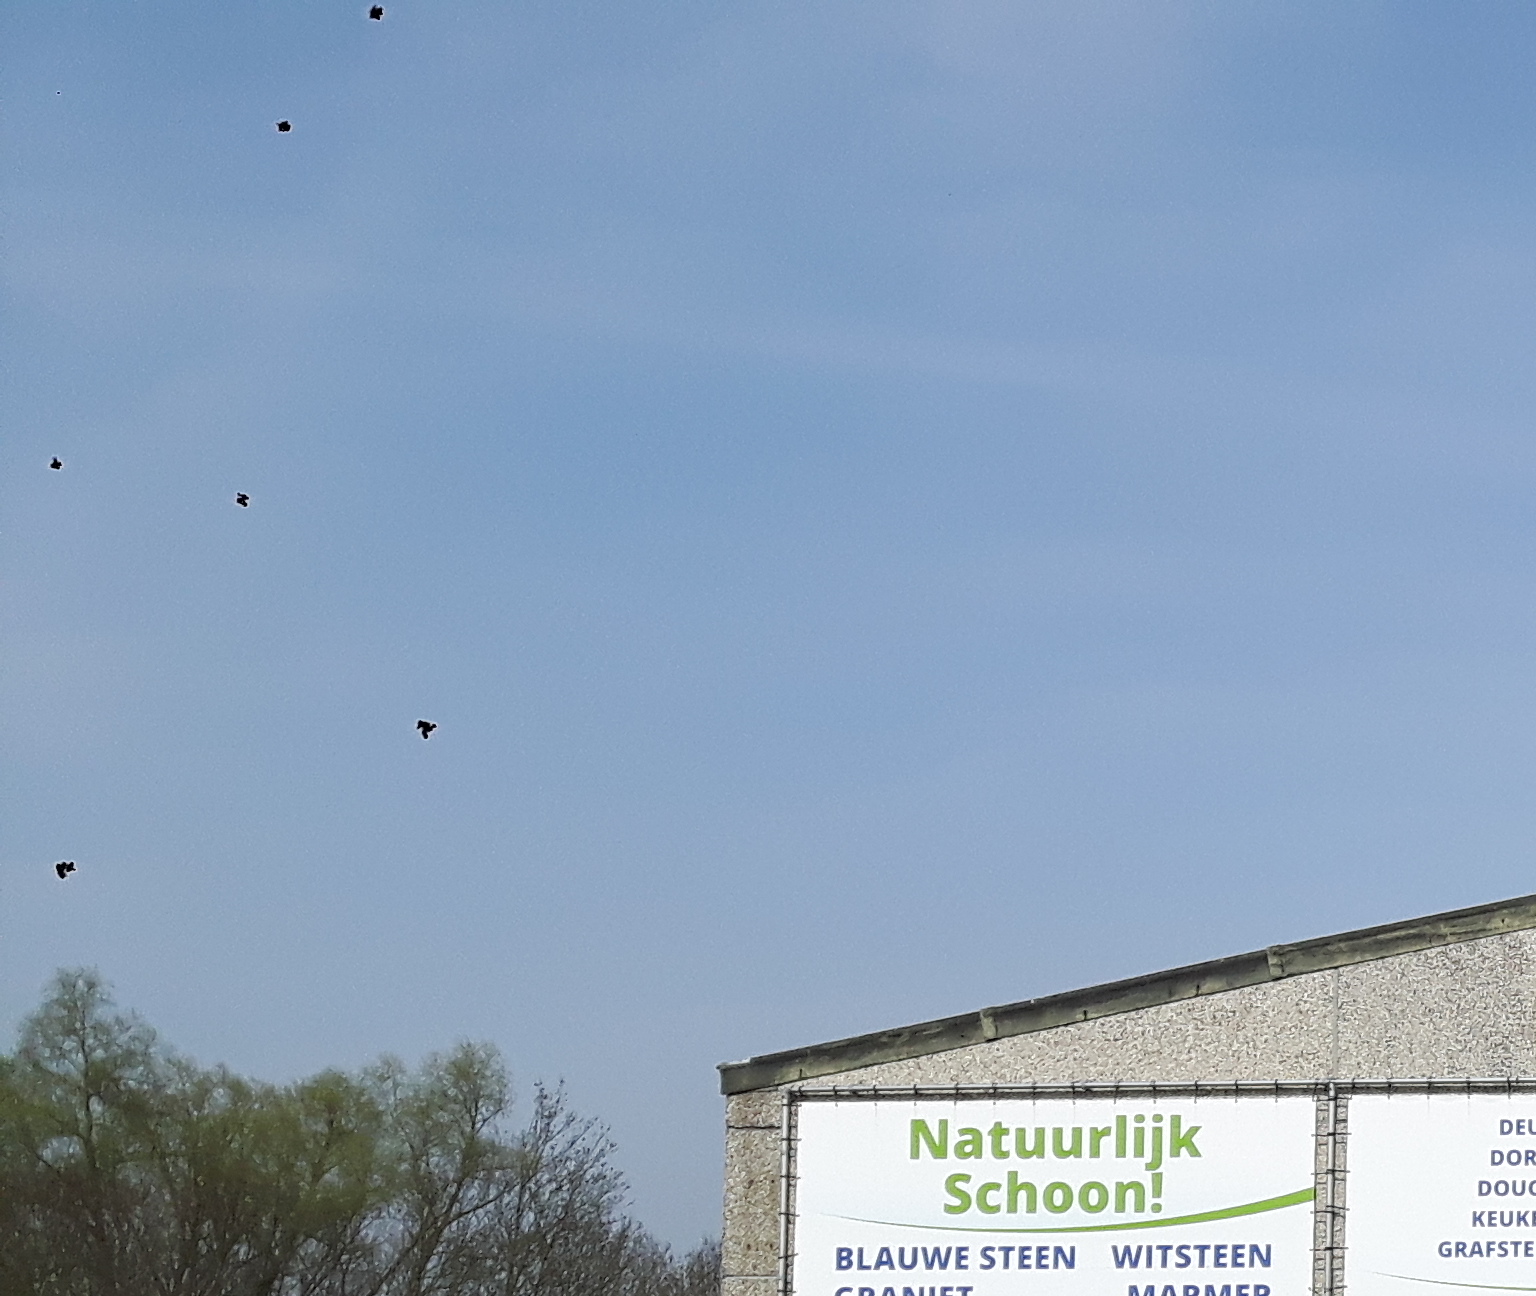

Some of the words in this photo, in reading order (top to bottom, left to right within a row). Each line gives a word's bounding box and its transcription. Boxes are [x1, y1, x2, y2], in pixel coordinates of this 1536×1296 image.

[910, 1115, 1201, 1170] Natuurlijk
[943, 1171, 1163, 1213] Schoon!
[836, 1247, 969, 1270] BLAUWE
[980, 1246, 1075, 1270] STEEN
[1112, 1244, 1271, 1268] WITSTEEN
